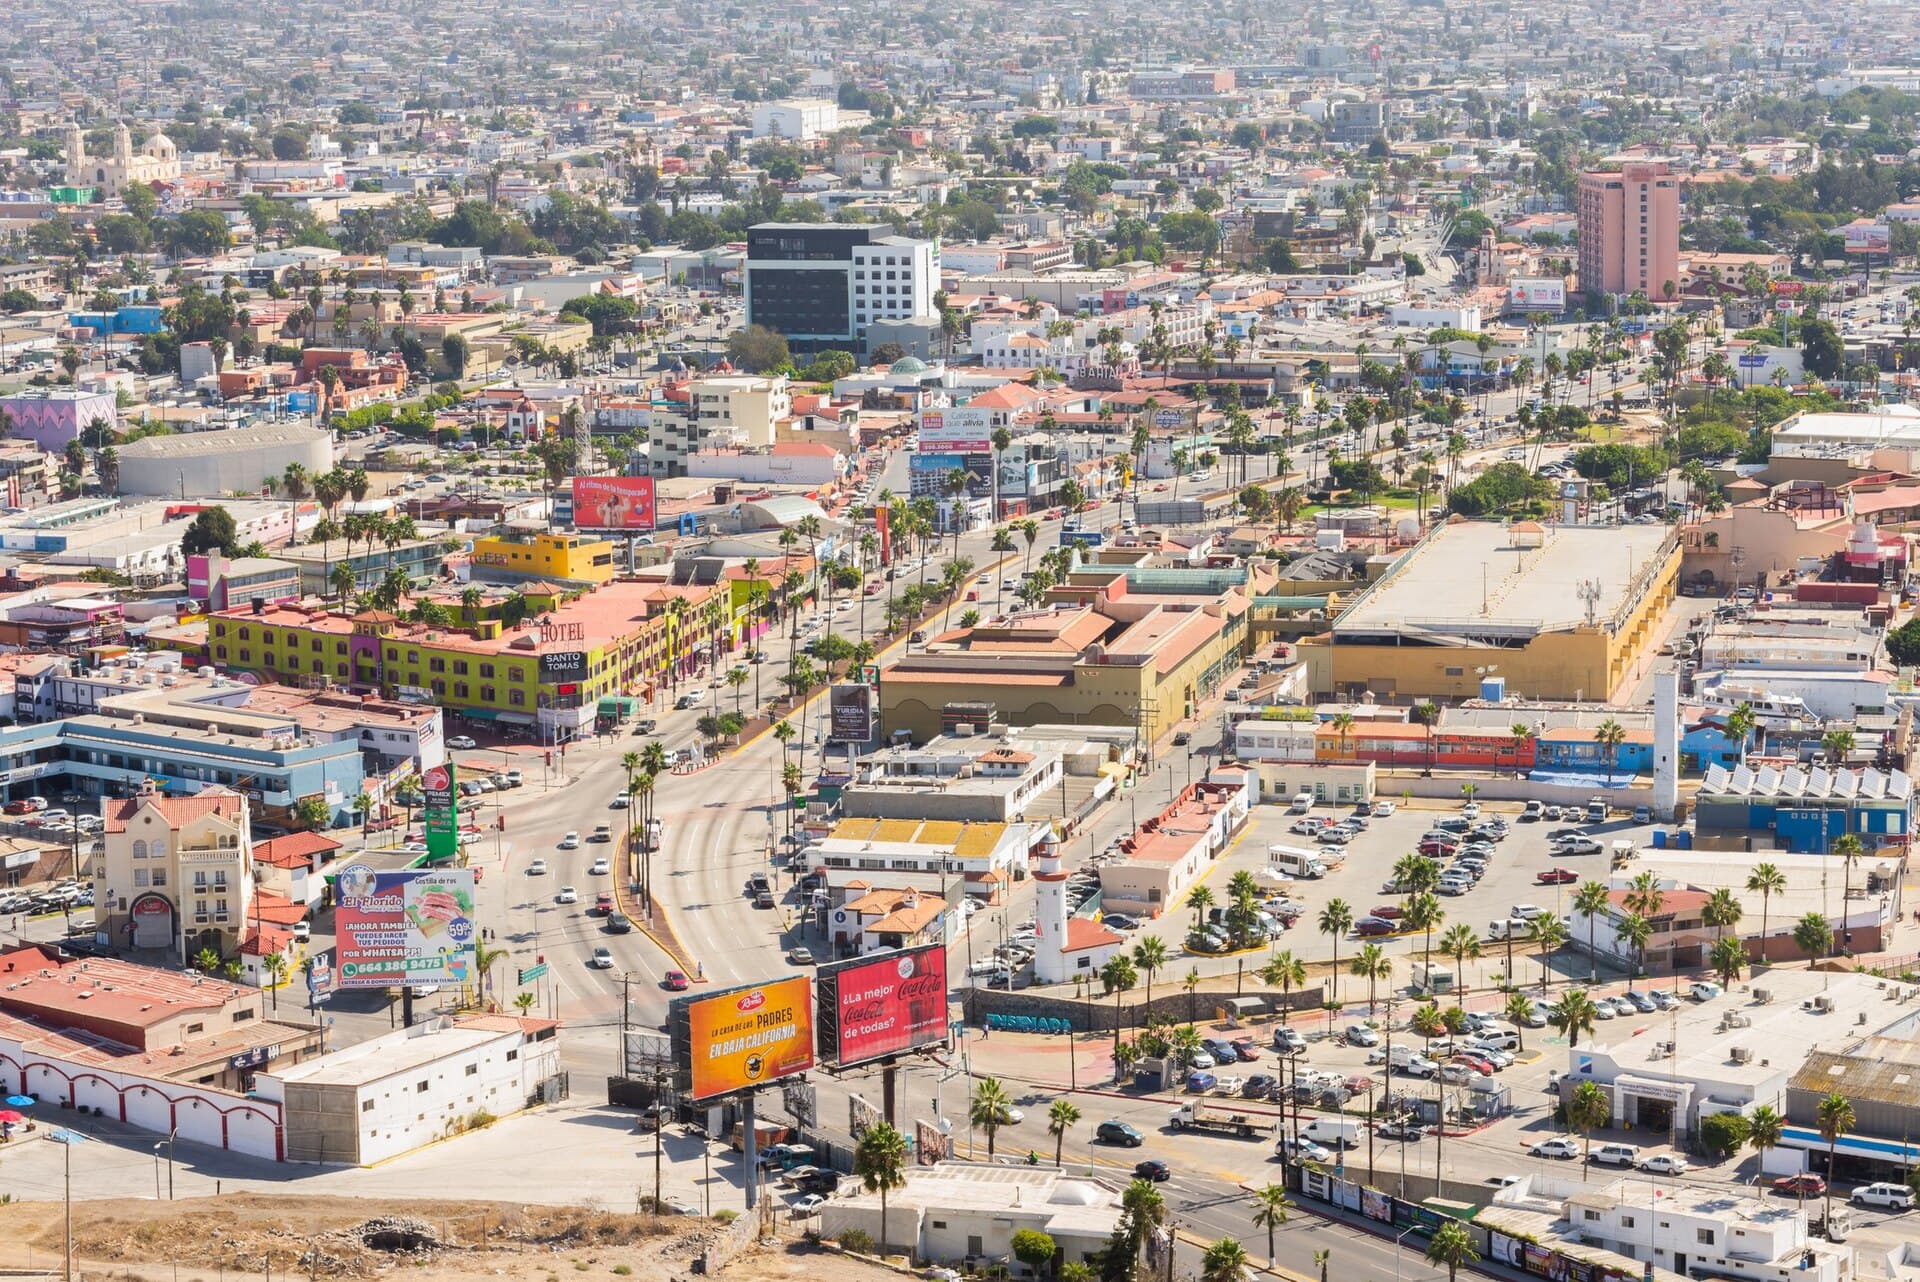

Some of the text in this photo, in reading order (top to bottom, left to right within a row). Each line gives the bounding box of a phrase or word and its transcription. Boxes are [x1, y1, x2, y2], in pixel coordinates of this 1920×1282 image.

[983, 475, 991, 487] 3
[540, 622, 585, 643] HOTEL
[546, 652, 581, 663] SANTO
[547, 662, 579, 671] TOMAS
[426, 790, 451, 798] PEMEX
[415, 877, 437, 885] Costilla
[344, 895, 403, 907] El Florido
[343, 947, 422, 958] POR WHATSAPP!
[358, 958, 441, 973] 664 386 9475
[843, 985, 894, 1005] ¿La mejor
[711, 1028, 718, 1038] LA
[719, 1024, 734, 1035] CASA
[734, 1022, 742, 1031] DE
[743, 1020, 753, 1029] LOS
[756, 1007, 793, 1028] PADRES
[844, 1017, 896, 1039] de todas?
[709, 1023, 797, 1059] EN BAJA CALIFORNIA
